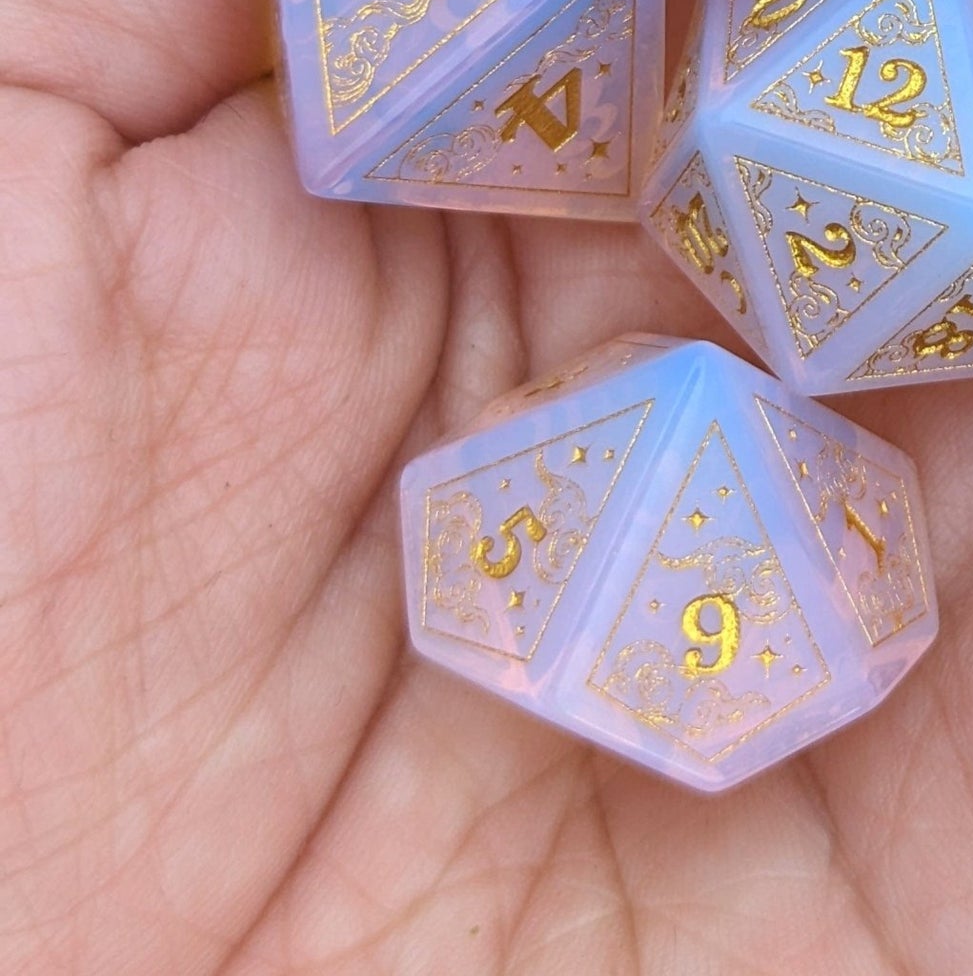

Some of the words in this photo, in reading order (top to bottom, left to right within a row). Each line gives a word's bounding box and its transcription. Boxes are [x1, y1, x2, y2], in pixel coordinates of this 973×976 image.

[494, 68, 583, 152] 4
[824, 45, 927, 128] 12
[785, 223, 856, 278] 2
[471, 506, 547, 579] 5
[845, 498, 886, 575] 1
[682, 593, 742, 674] 9
